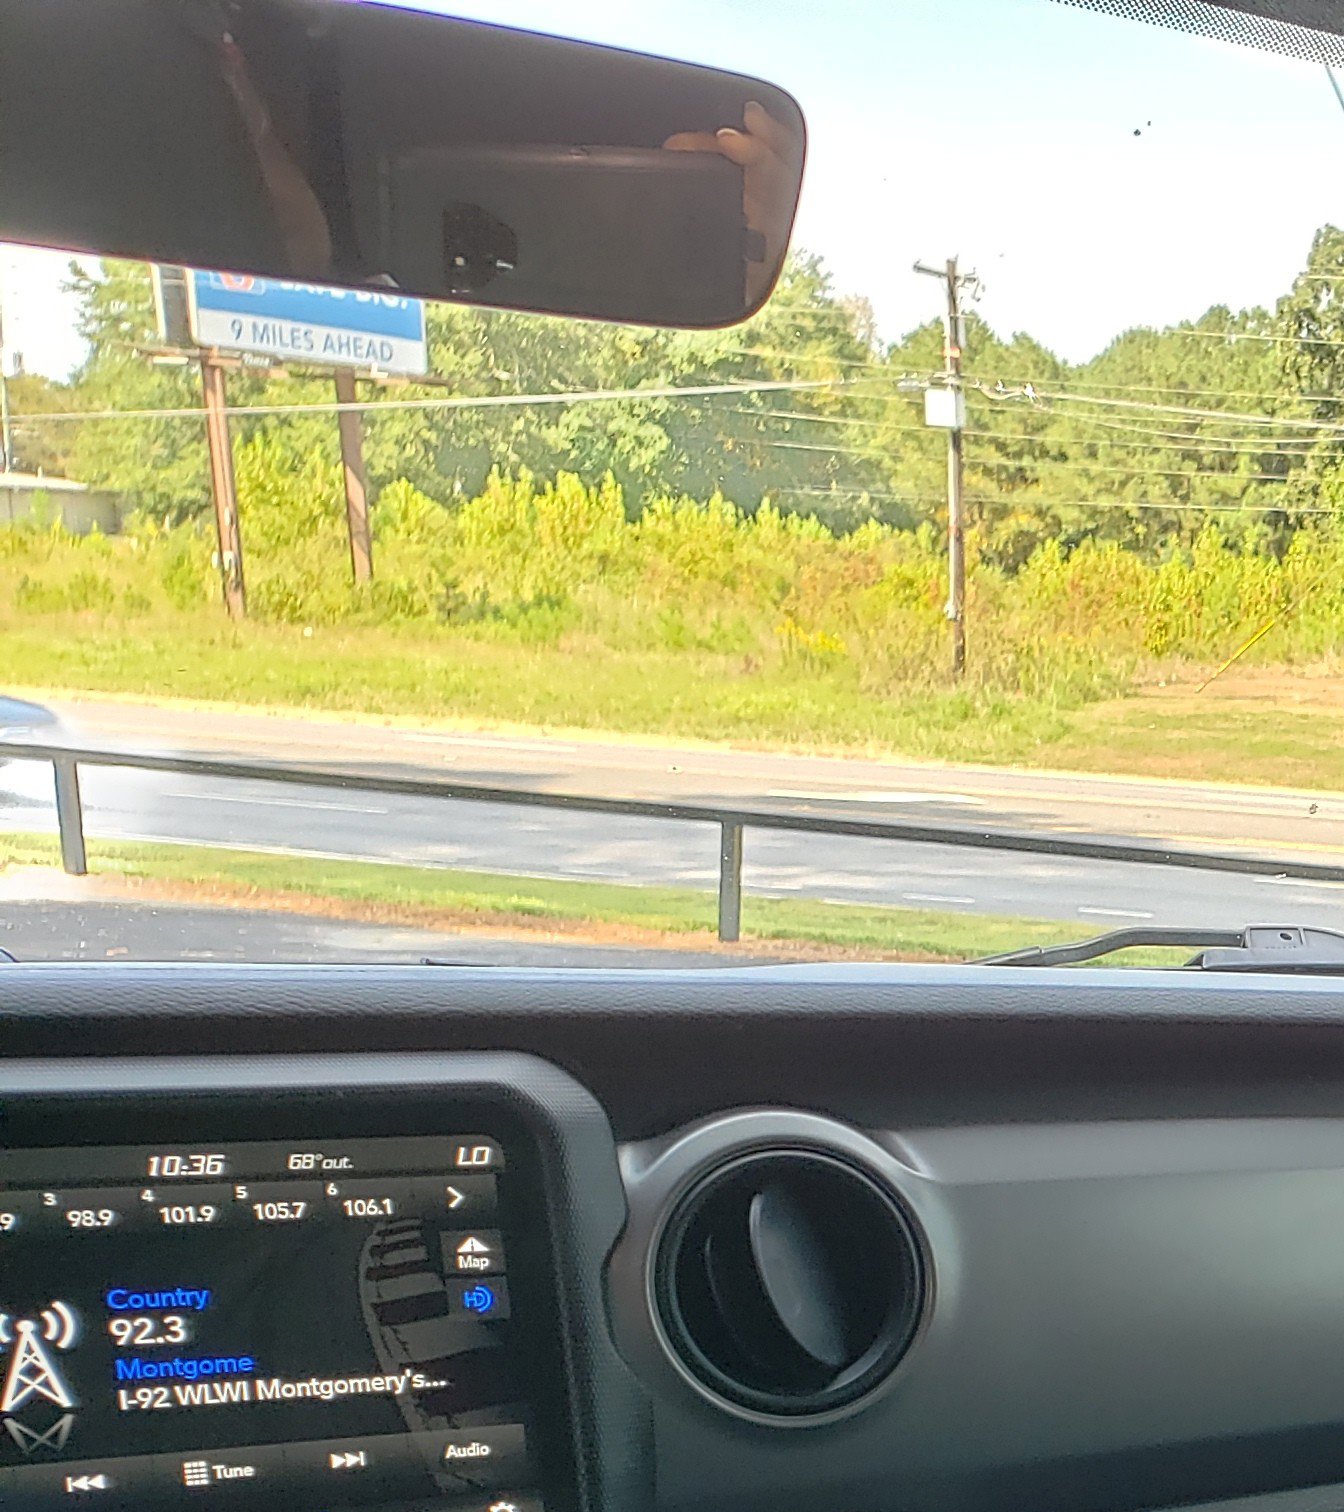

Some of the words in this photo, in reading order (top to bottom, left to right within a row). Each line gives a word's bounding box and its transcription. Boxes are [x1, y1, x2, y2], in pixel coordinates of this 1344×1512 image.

[230, 318, 243, 341] 9
[251, 321, 314, 351] MILES
[322, 333, 394, 363] AHEAD
[148, 1153, 226, 1176] 10:36
[456, 1146, 491, 1166] LO
[140, 1189, 155, 1203] 4
[234, 1186, 248, 1200] 5
[326, 1183, 339, 1196] 6
[43, 1193, 57, 1206] 3
[343, 1198, 394, 1217] 106.1
[66, 1208, 115, 1228] 98.9
[159, 1205, 216, 1224] 101.9
[253, 1201, 306, 1221] 105.7
[458, 1254, 490, 1271] Map
[106, 1287, 210, 1310] Country
[109, 1316, 187, 1345] 92.3
[115, 1356, 254, 1380] Montgome
[118, 1387, 173, 1410] I-92
[175, 1380, 250, 1406] WLWI
[445, 1443, 490, 1459] Audio
[212, 1464, 254, 1479] Tune
